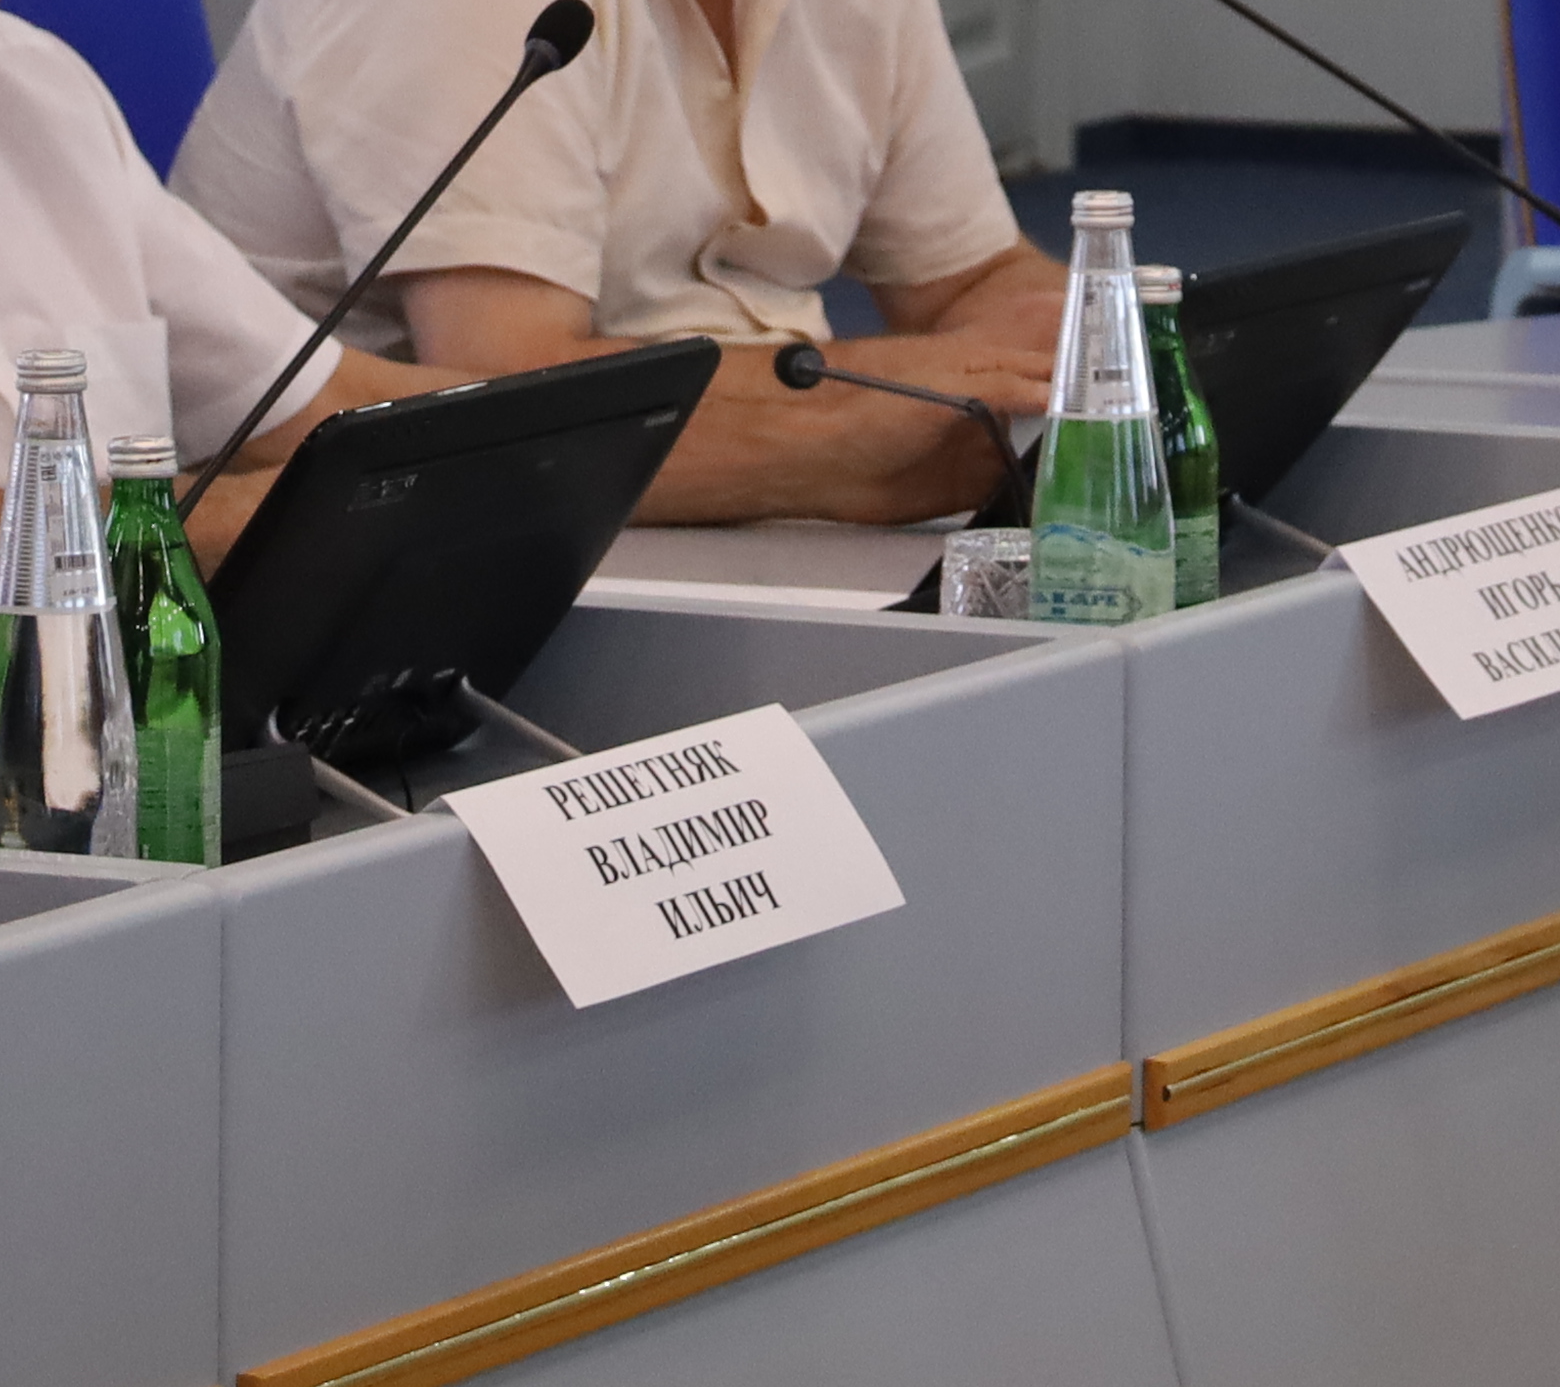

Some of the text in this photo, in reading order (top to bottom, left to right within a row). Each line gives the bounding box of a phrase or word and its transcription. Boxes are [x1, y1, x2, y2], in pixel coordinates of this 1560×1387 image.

[543, 739, 742, 821] РЕШЕТНЯК
[586, 797, 774, 886] ВЛАДИМИР
[655, 870, 782, 940] ИЛЬИЧ
